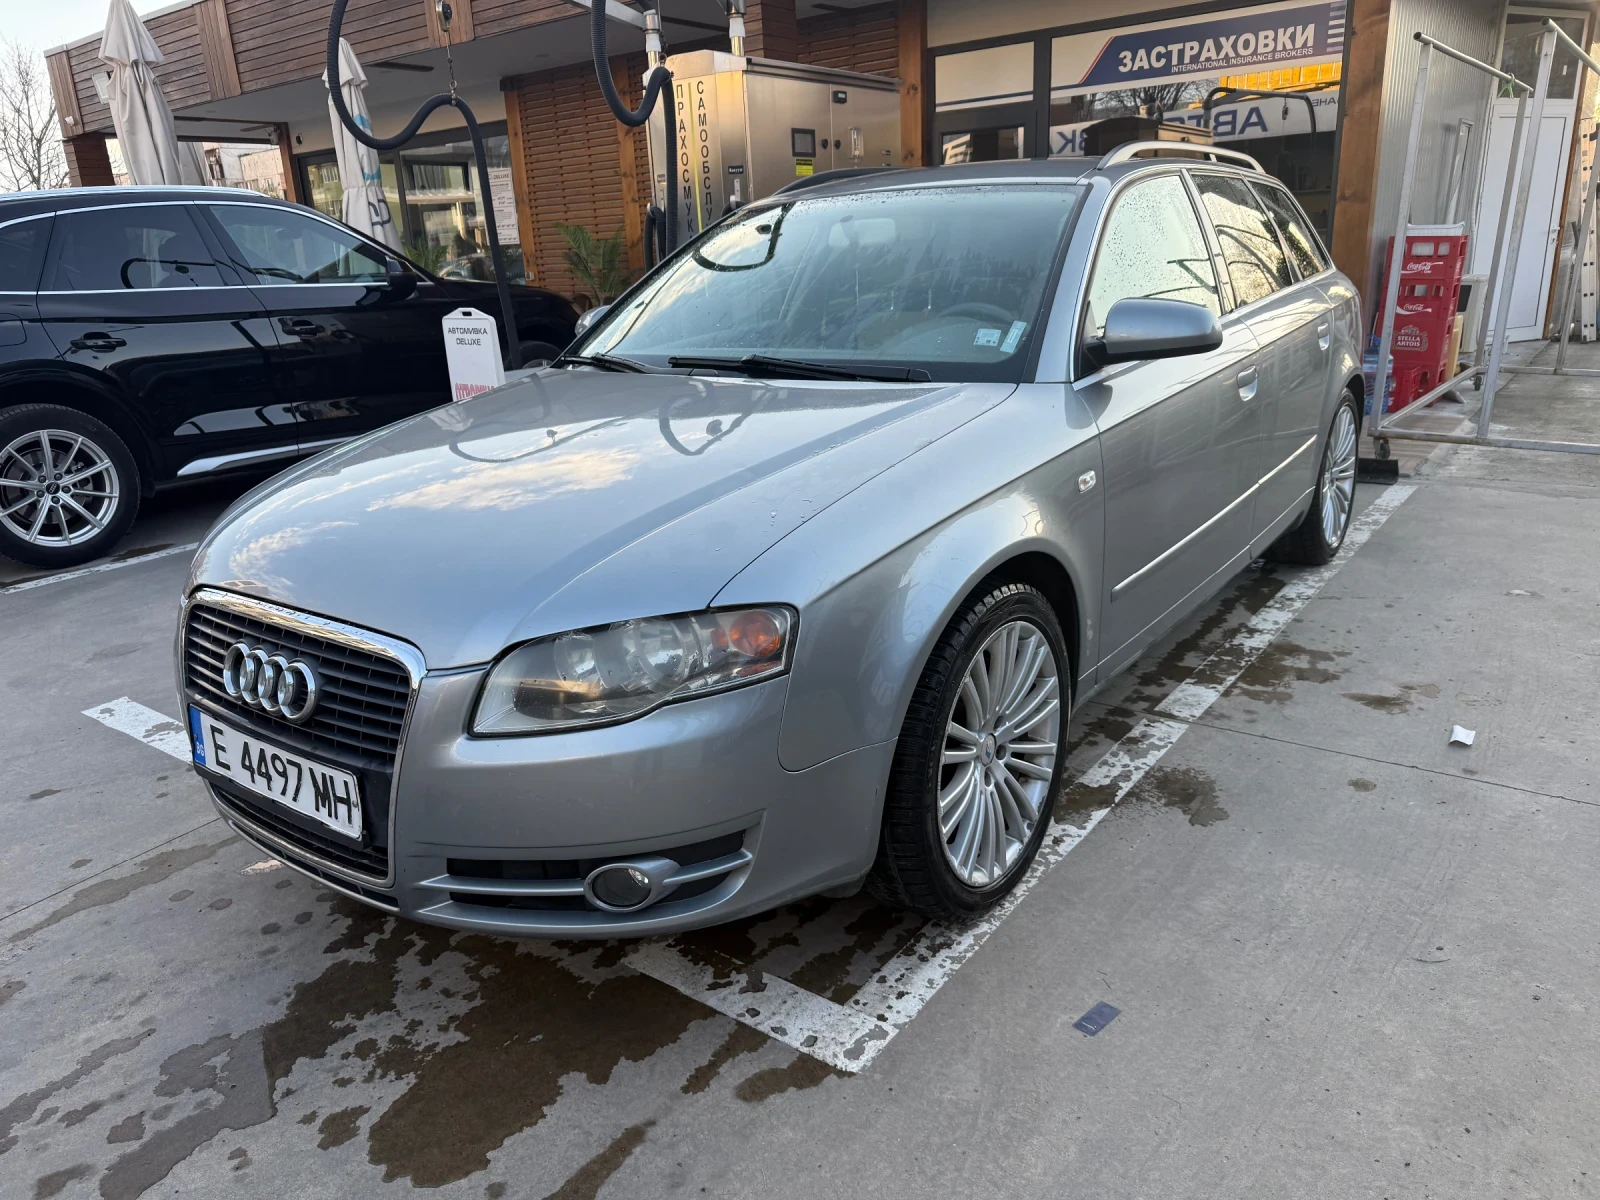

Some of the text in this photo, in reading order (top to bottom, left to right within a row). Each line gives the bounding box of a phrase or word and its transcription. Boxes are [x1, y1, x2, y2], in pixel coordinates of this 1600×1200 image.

[1118, 23, 1315, 73] ЗАСТРАХОВКИ
[1171, 47, 1314, 73] INTERNATIONAL INSURANCE BROKERS
[676, 84, 694, 237] ПРАХОСМУК
[697, 81, 713, 227] САМООБСЛУ
[447, 327, 488, 335] АВТОМИВКА
[456, 337, 482, 346] DELUXE
[196, 742, 206, 757] BG
[210, 724, 353, 826] E 4497 MH
